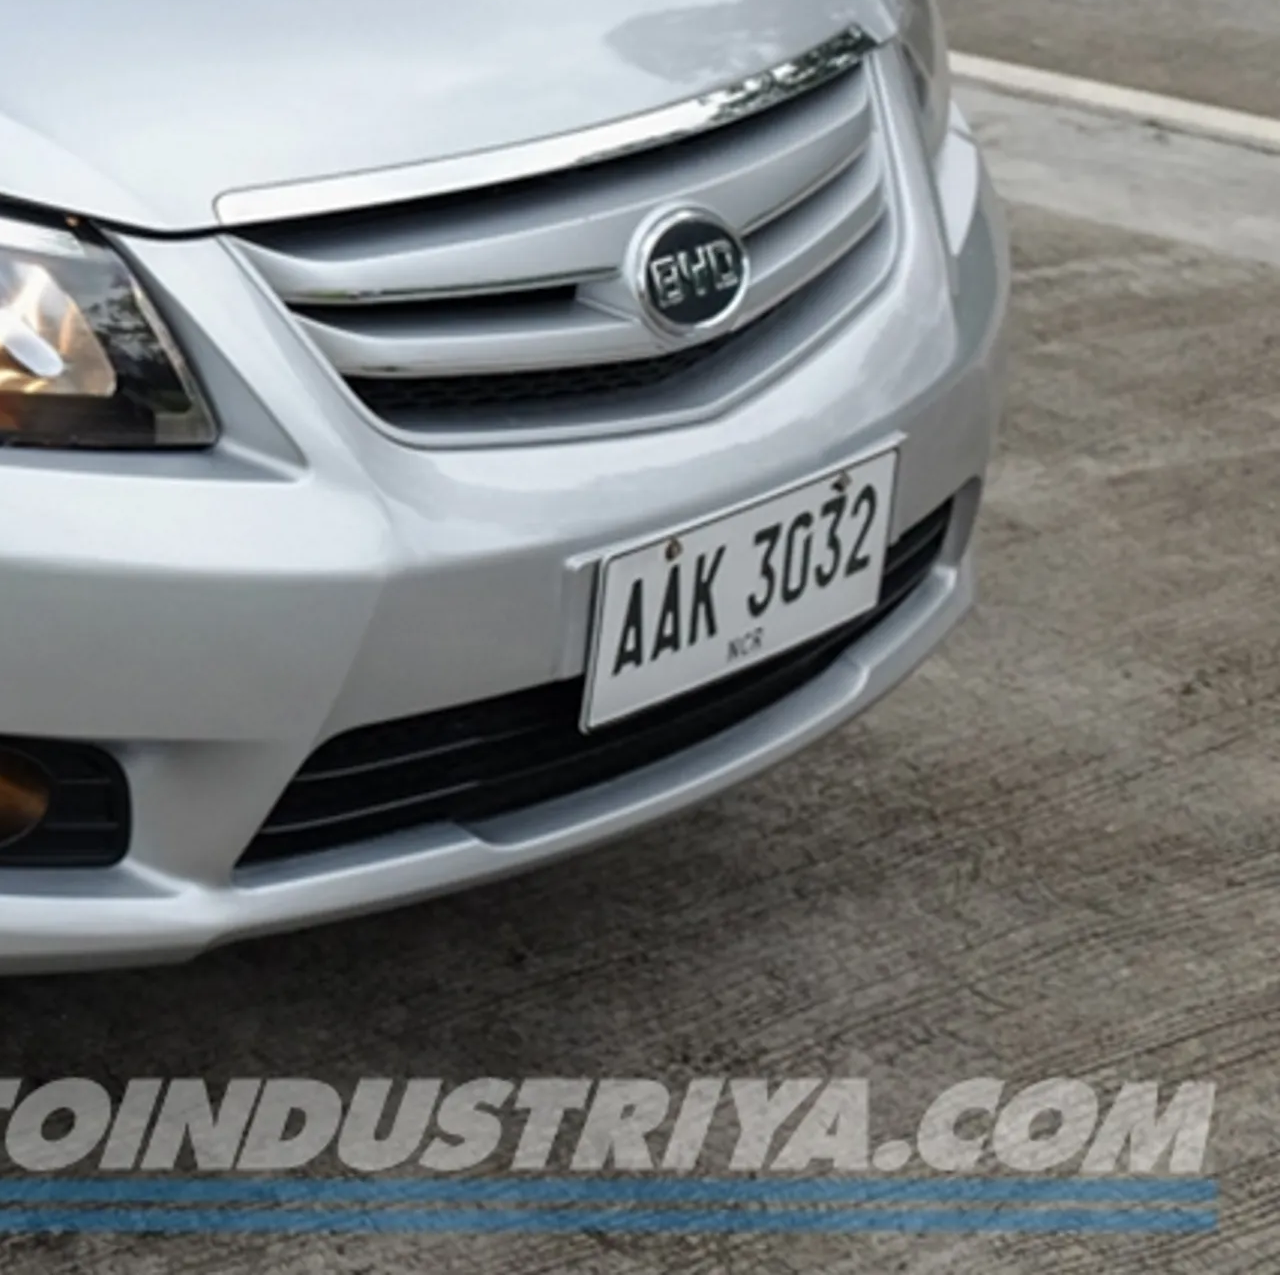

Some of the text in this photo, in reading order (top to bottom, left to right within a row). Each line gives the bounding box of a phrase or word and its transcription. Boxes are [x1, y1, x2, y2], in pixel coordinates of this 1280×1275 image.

[650, 239, 739, 309] BYD
[612, 483, 877, 676] AAK 3032
[726, 627, 764, 663] NCR
